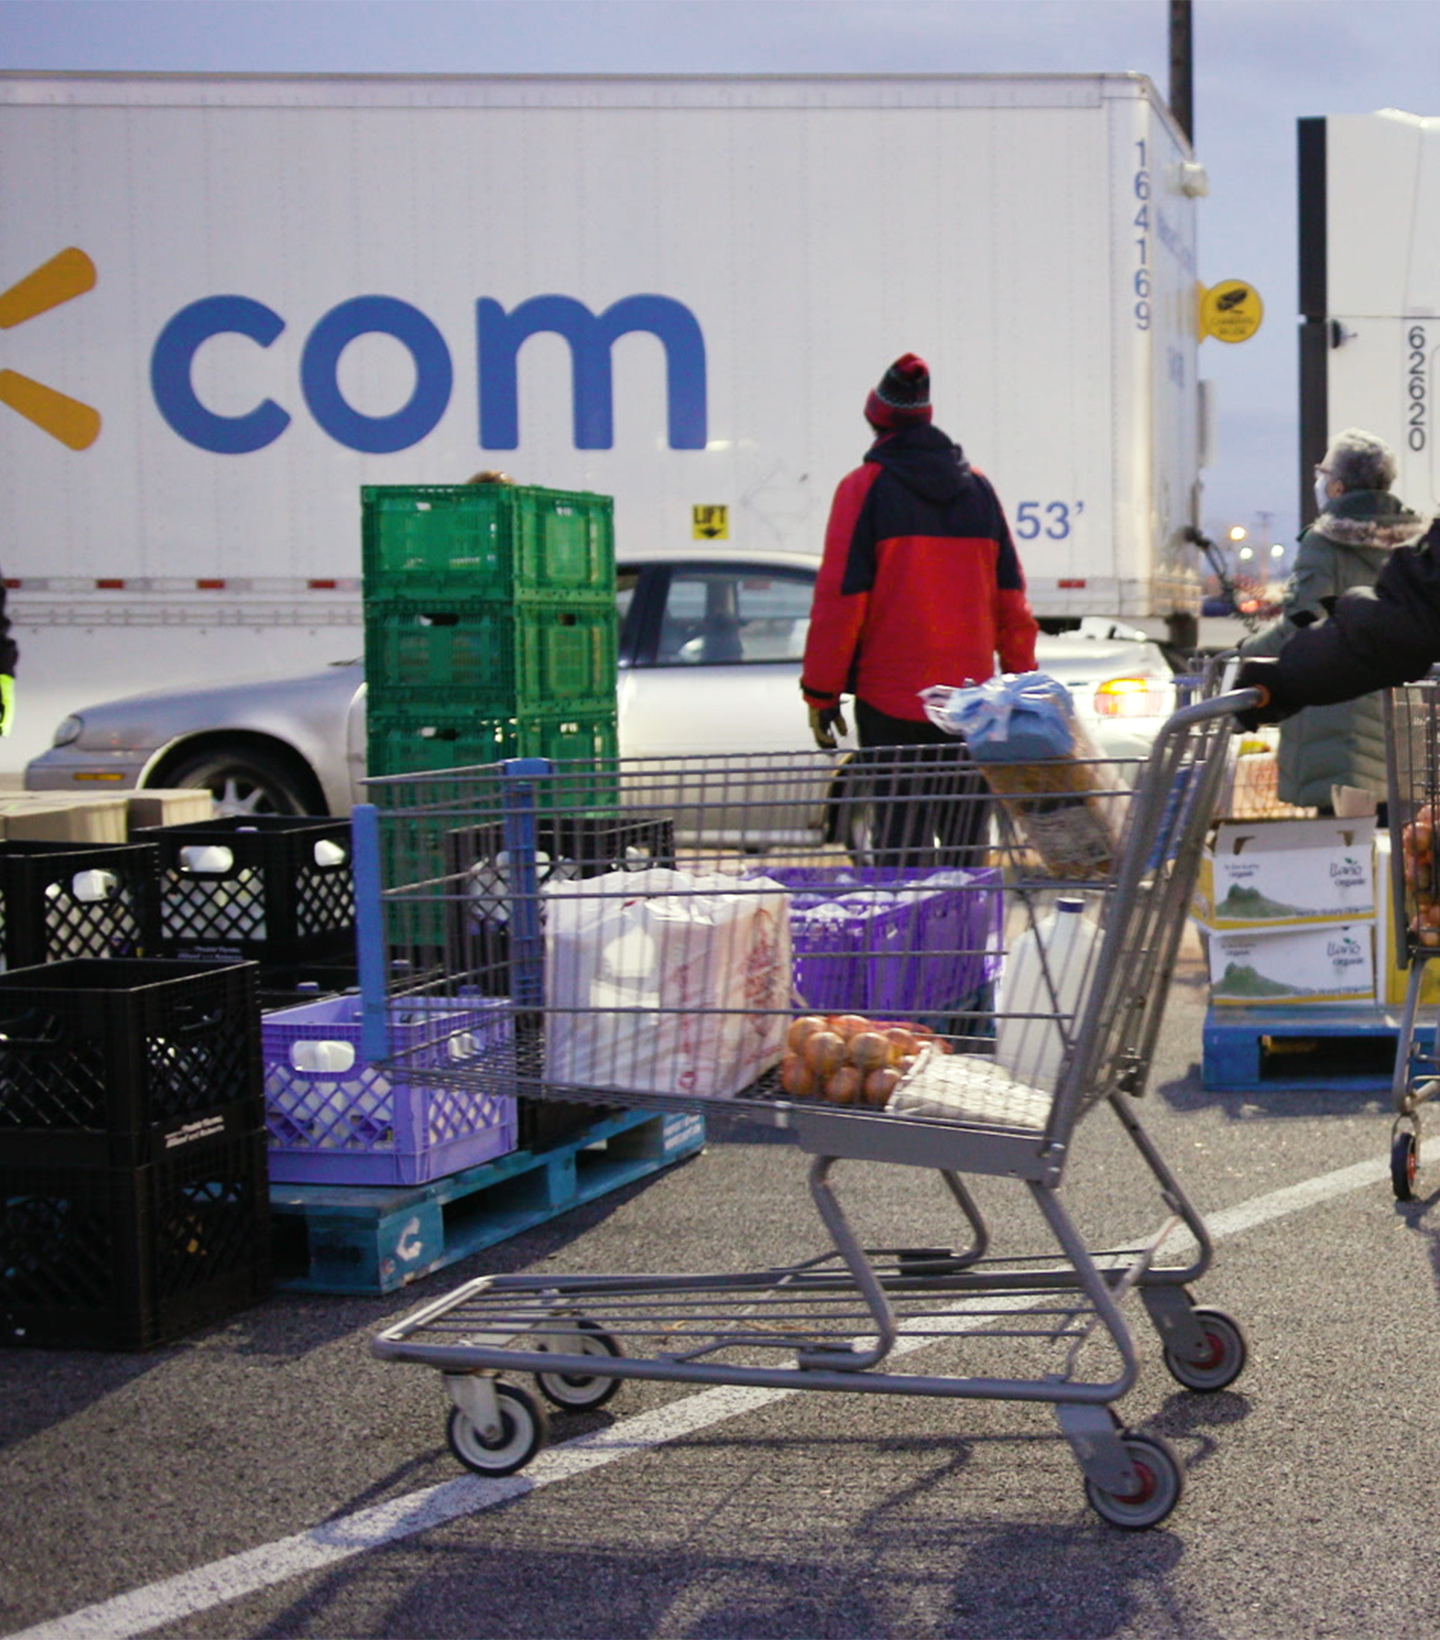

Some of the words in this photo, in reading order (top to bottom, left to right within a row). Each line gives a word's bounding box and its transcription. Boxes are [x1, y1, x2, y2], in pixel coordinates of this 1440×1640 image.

[1134, 137, 1150, 331] 164169
[150, 293, 707, 455] com
[1408, 325, 1426, 452] 62620
[694, 505, 727, 524] LIFT
